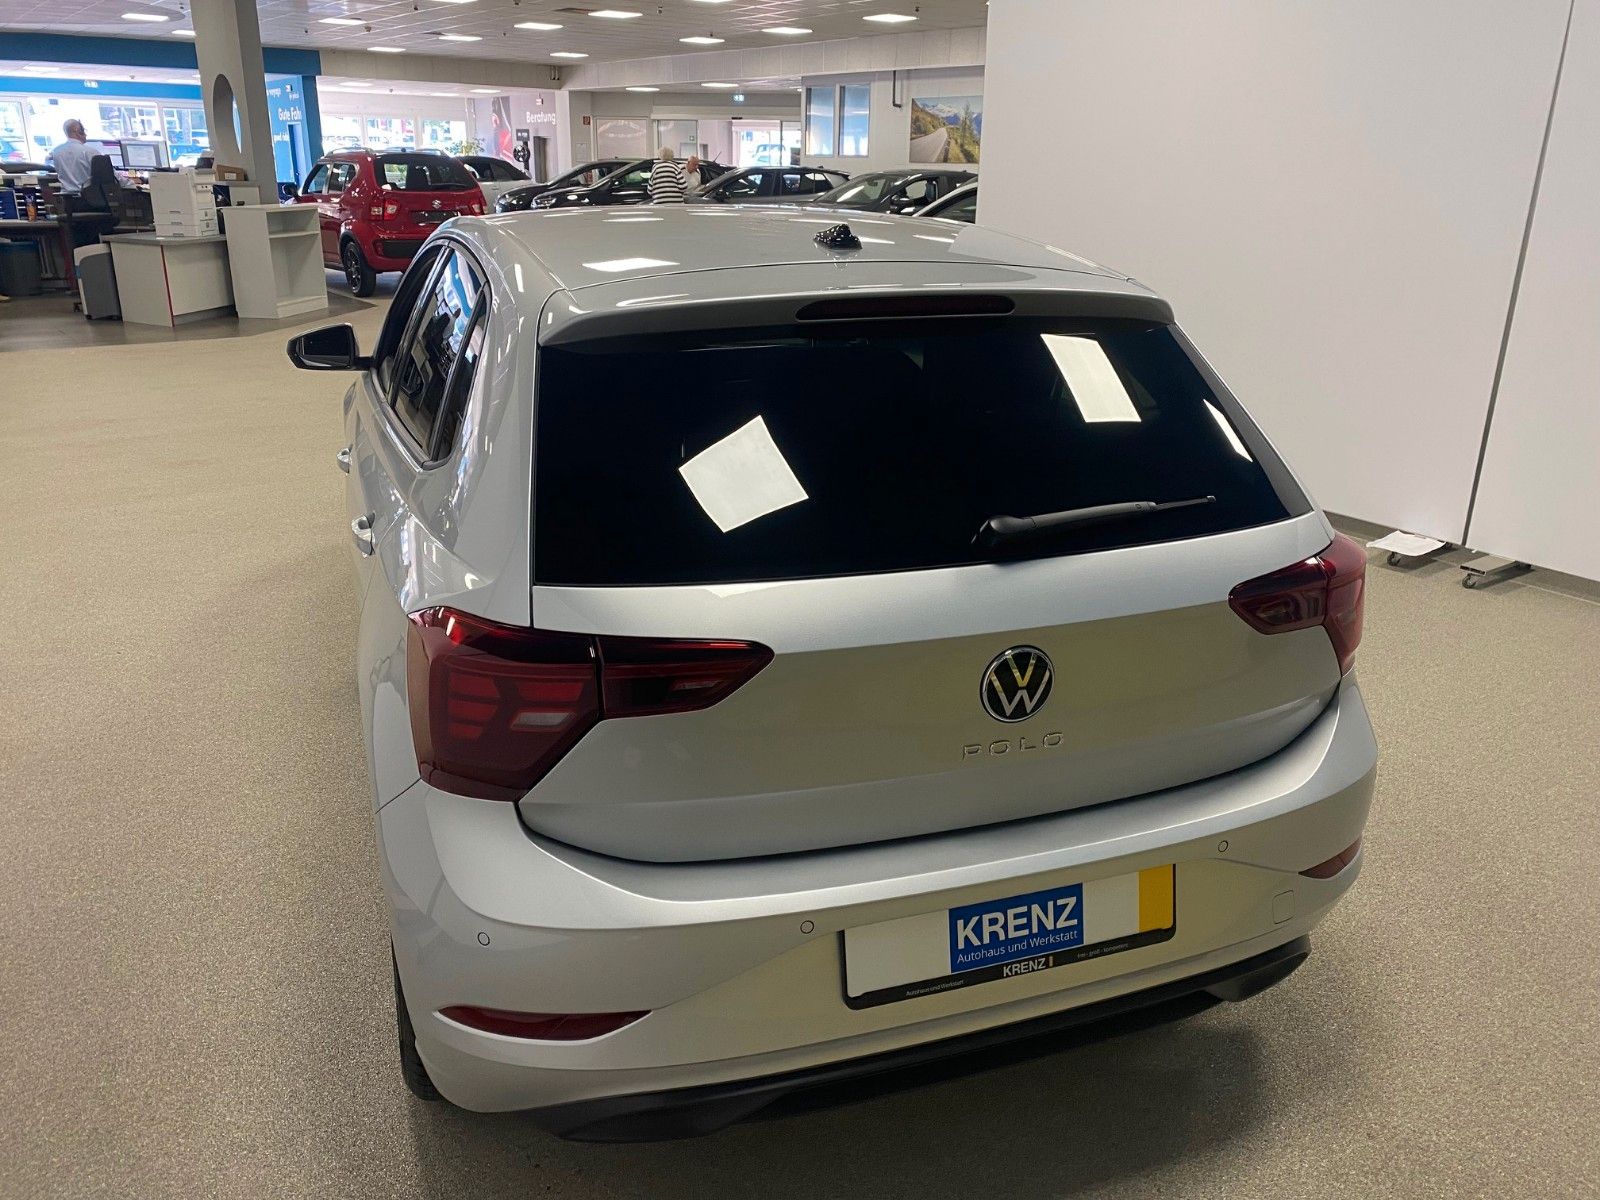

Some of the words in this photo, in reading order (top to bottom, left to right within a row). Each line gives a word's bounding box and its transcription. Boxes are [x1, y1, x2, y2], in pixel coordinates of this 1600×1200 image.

[526, 111, 556, 125] Beratung
[962, 731, 1063, 760] POLO
[956, 896, 1079, 950] KRENZ
[956, 946, 1006, 964] Autohaus
[1007, 939, 1028, 953] und
[1029, 930, 1078, 948] Werkstatt
[1003, 957, 1046, 977] KRENZ
[905, 987, 930, 997] Autohaus
[930, 984, 941, 992] und
[941, 979, 965, 989] Werkstatt
